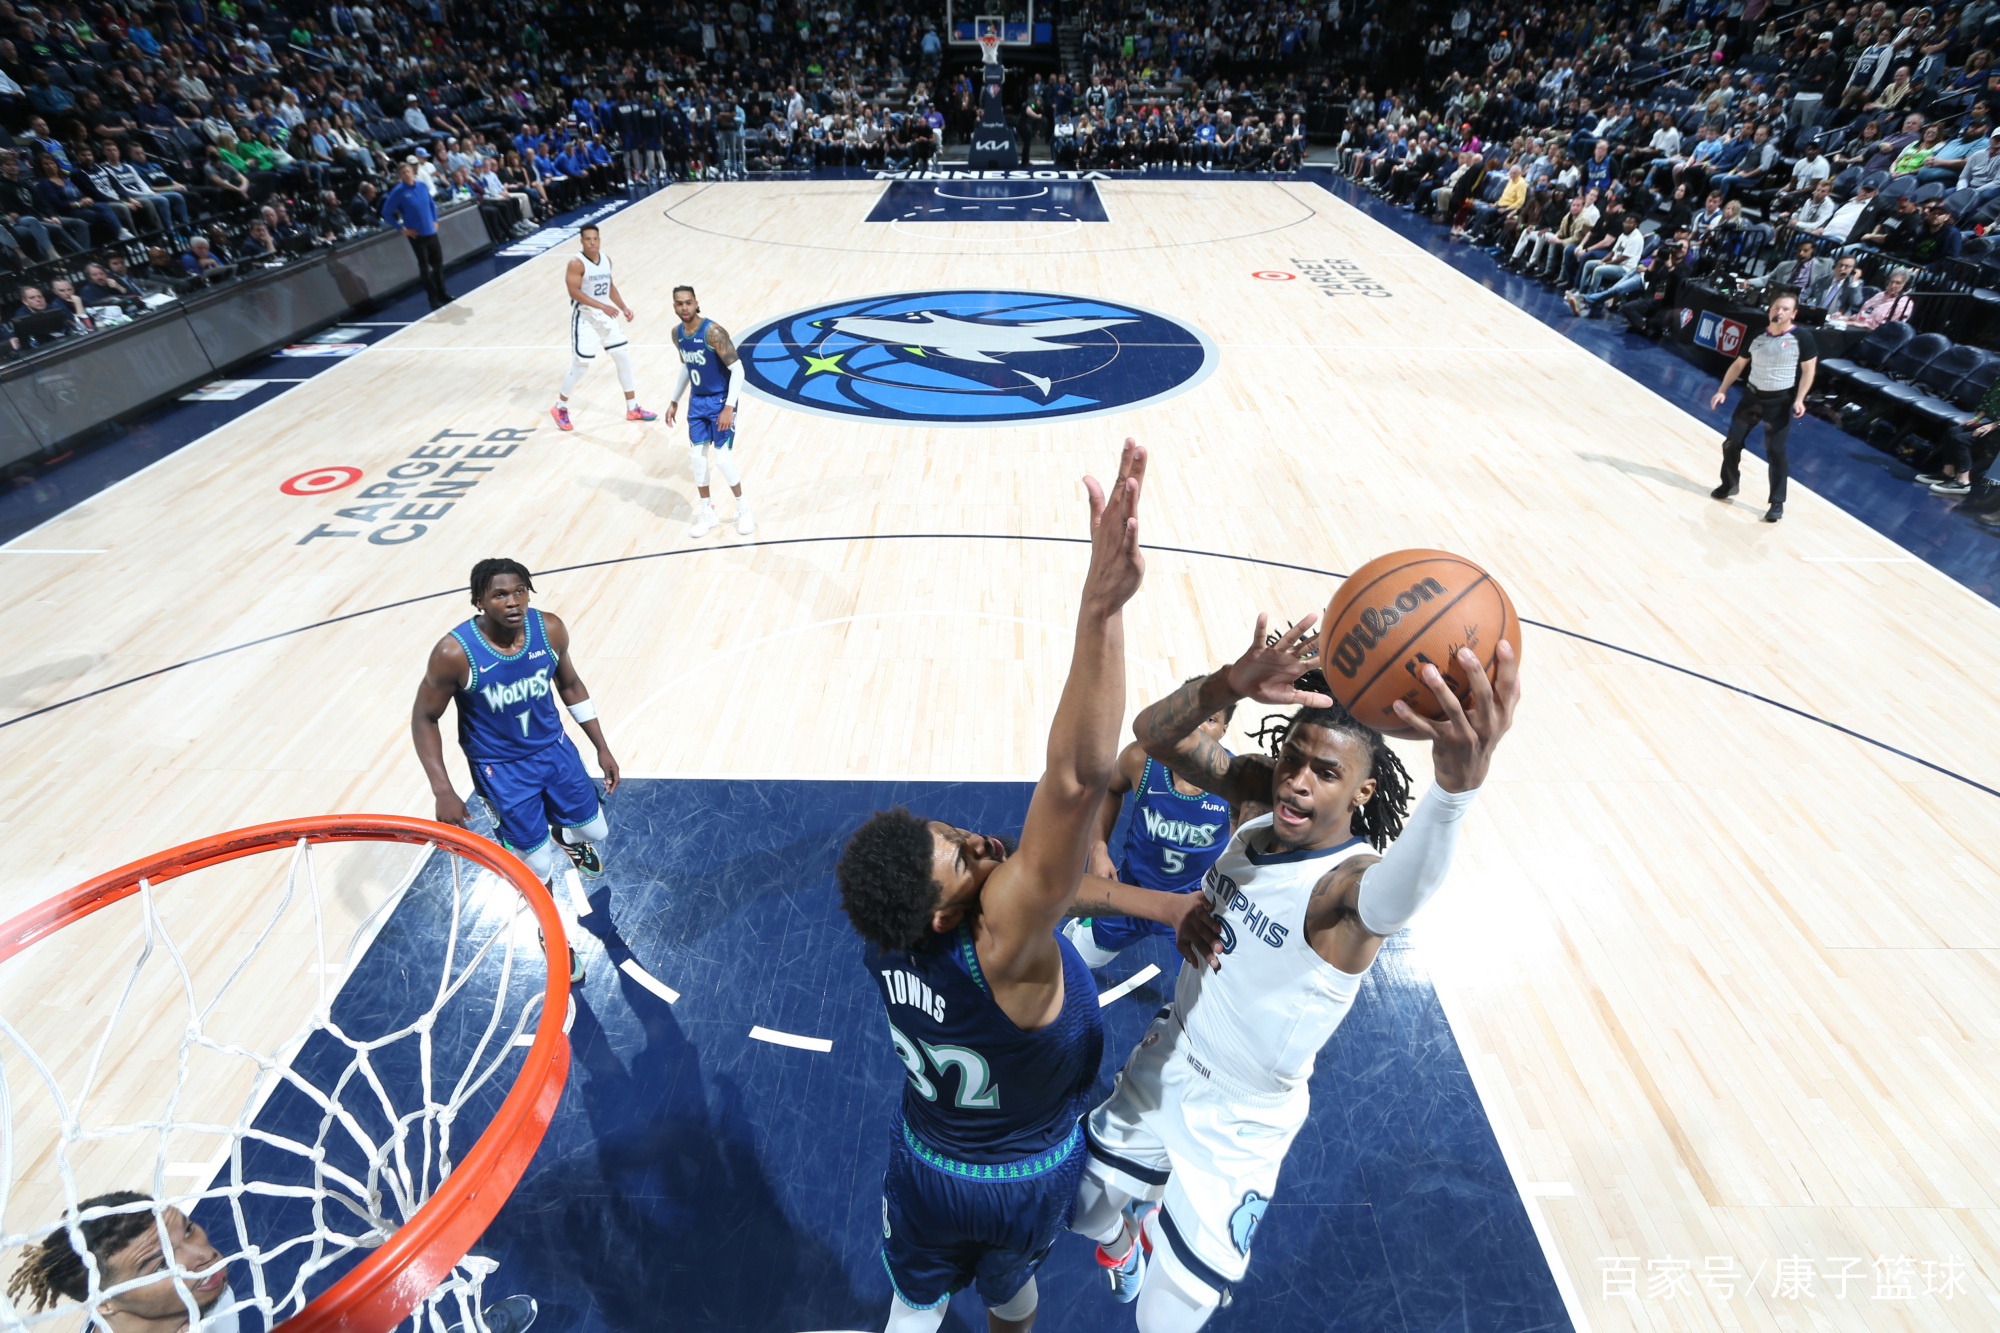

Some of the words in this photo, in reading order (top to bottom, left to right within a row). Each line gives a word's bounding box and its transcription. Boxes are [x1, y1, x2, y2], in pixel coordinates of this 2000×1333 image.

[874, 170, 1112, 180] MINNESOTA
[594, 282, 608, 296] 22
[1289, 258, 1355, 297] TARGET
[1323, 258, 1393, 298] CENTER
[690, 368, 701, 387] 0
[295, 428, 479, 545] TARGET
[368, 428, 538, 545] CENTER
[1330, 577, 1448, 679] Wilson
[480, 664, 550, 713] WOLVES
[515, 709, 531, 738] 1
[1141, 806, 1222, 848] WOLVES
[1161, 848, 1188, 874] 5
[1206, 862, 1289, 948] EMPHIS
[881, 969, 946, 1024] TOWNS
[887, 1022, 1000, 1109] 32
